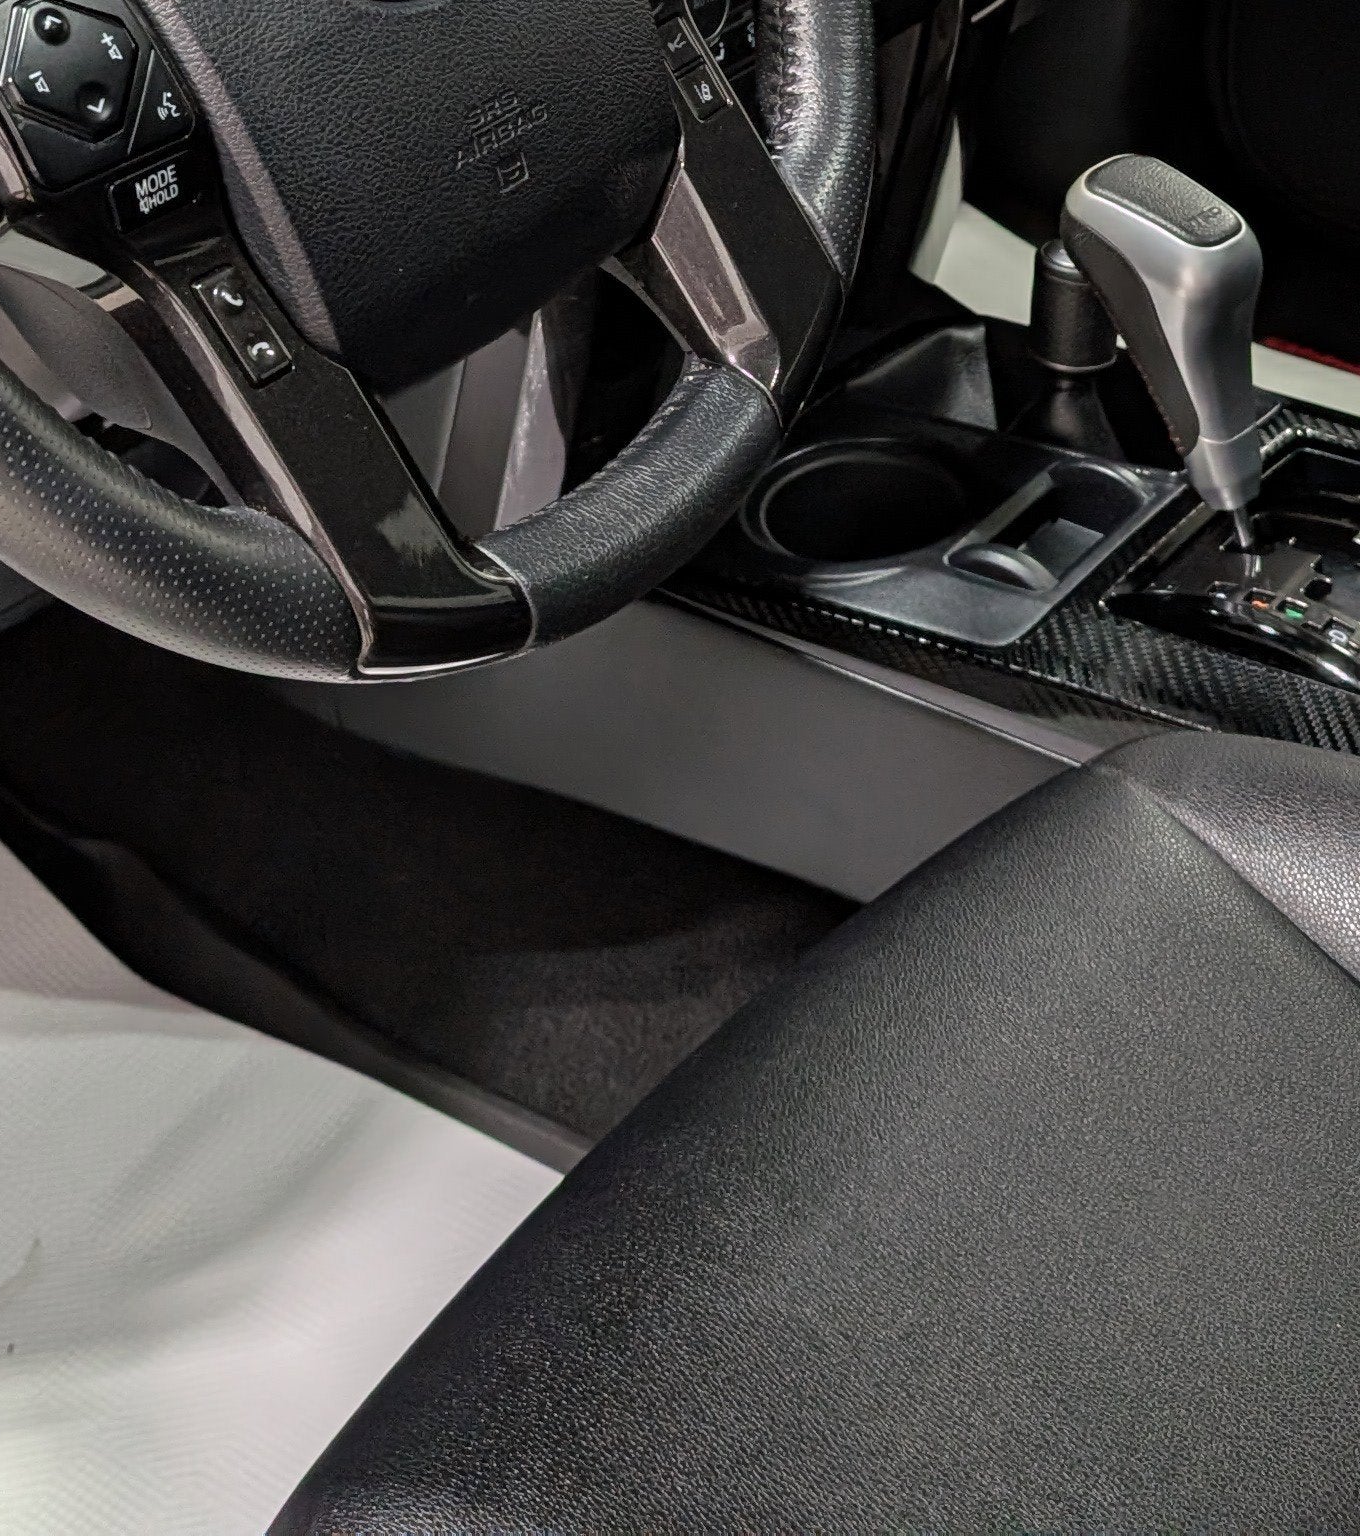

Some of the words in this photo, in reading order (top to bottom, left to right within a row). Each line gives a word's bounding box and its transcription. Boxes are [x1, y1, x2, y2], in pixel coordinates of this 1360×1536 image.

[455, 104, 548, 170] AIRBAG
[135, 164, 178, 201] MODE
[148, 184, 179, 210] HOLD
